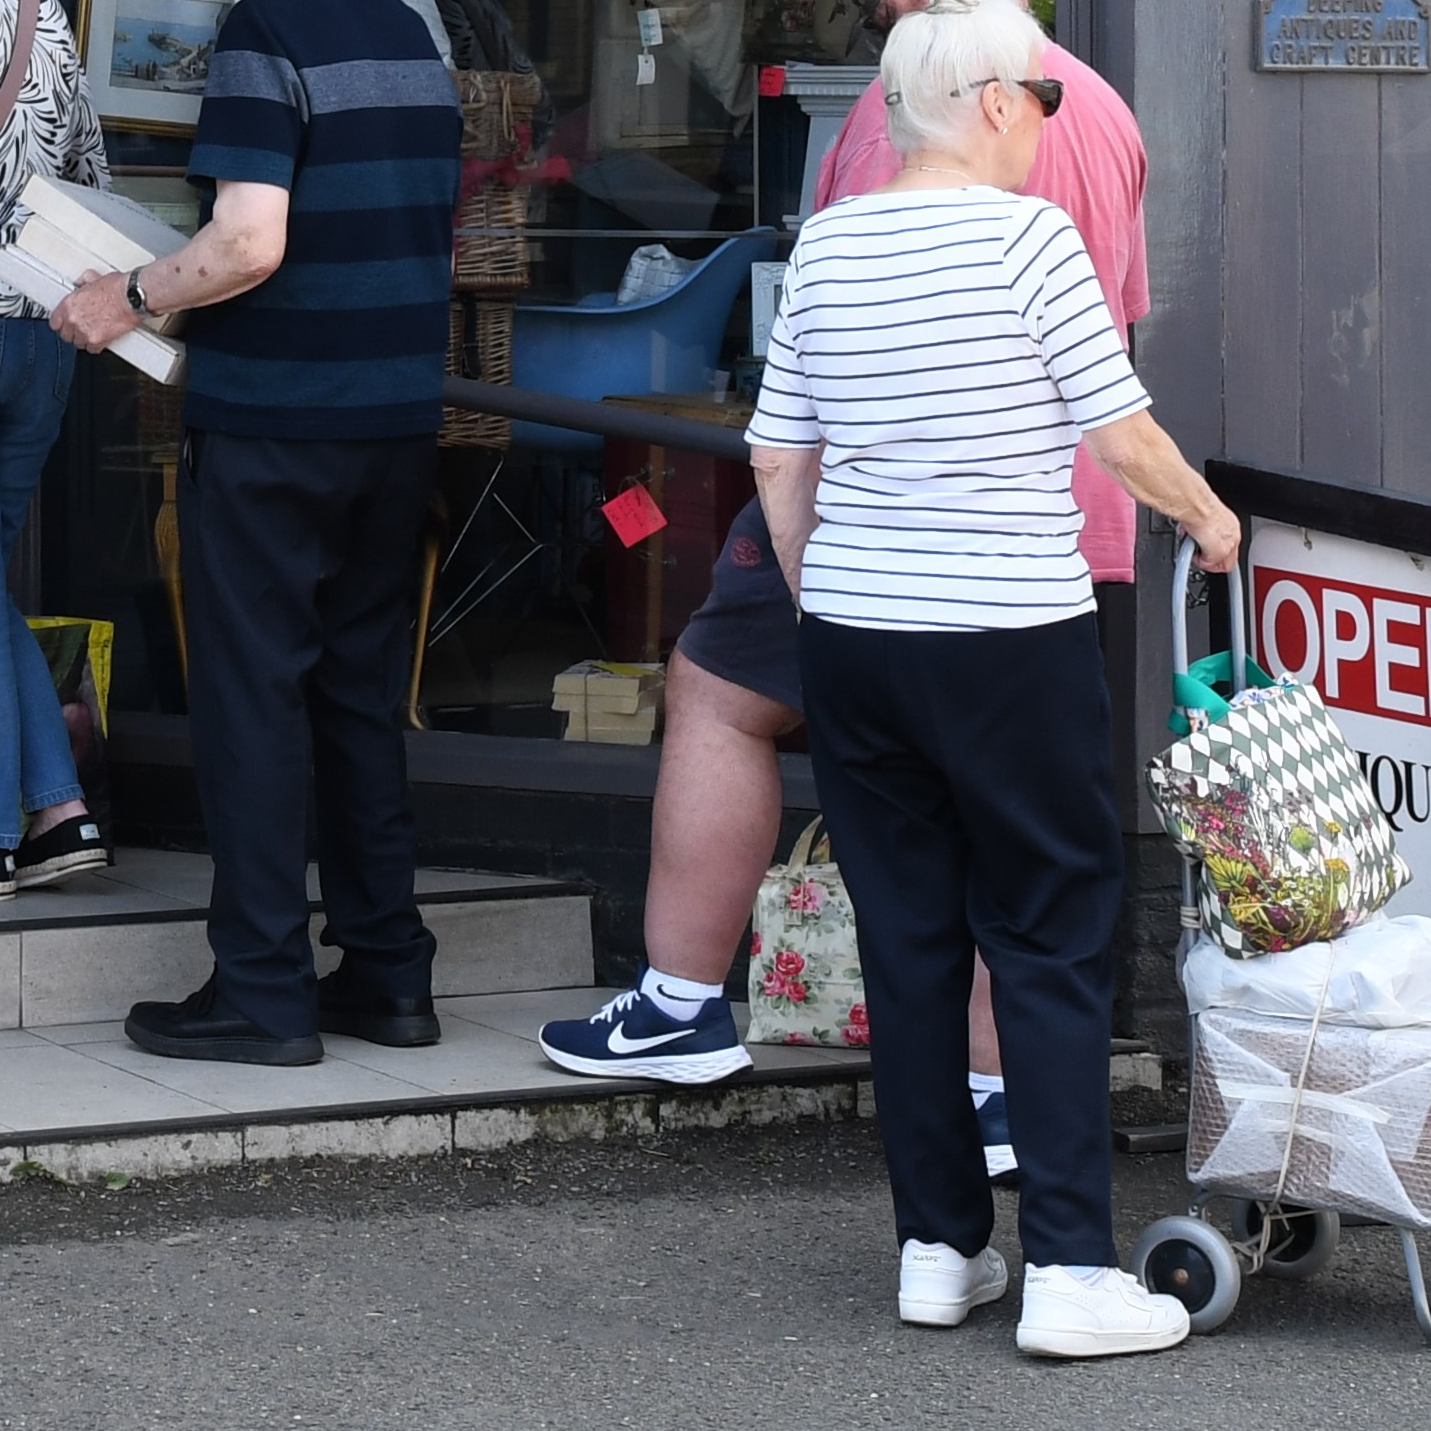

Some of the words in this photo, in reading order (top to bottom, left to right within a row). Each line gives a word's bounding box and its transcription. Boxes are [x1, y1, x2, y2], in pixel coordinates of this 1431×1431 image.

[1278, 15, 1373, 41] ANTIQUES
[1384, 16, 1419, 42] AND
[1271, 41, 1333, 65] CRAFT
[1345, 42, 1420, 67] CENTRE
